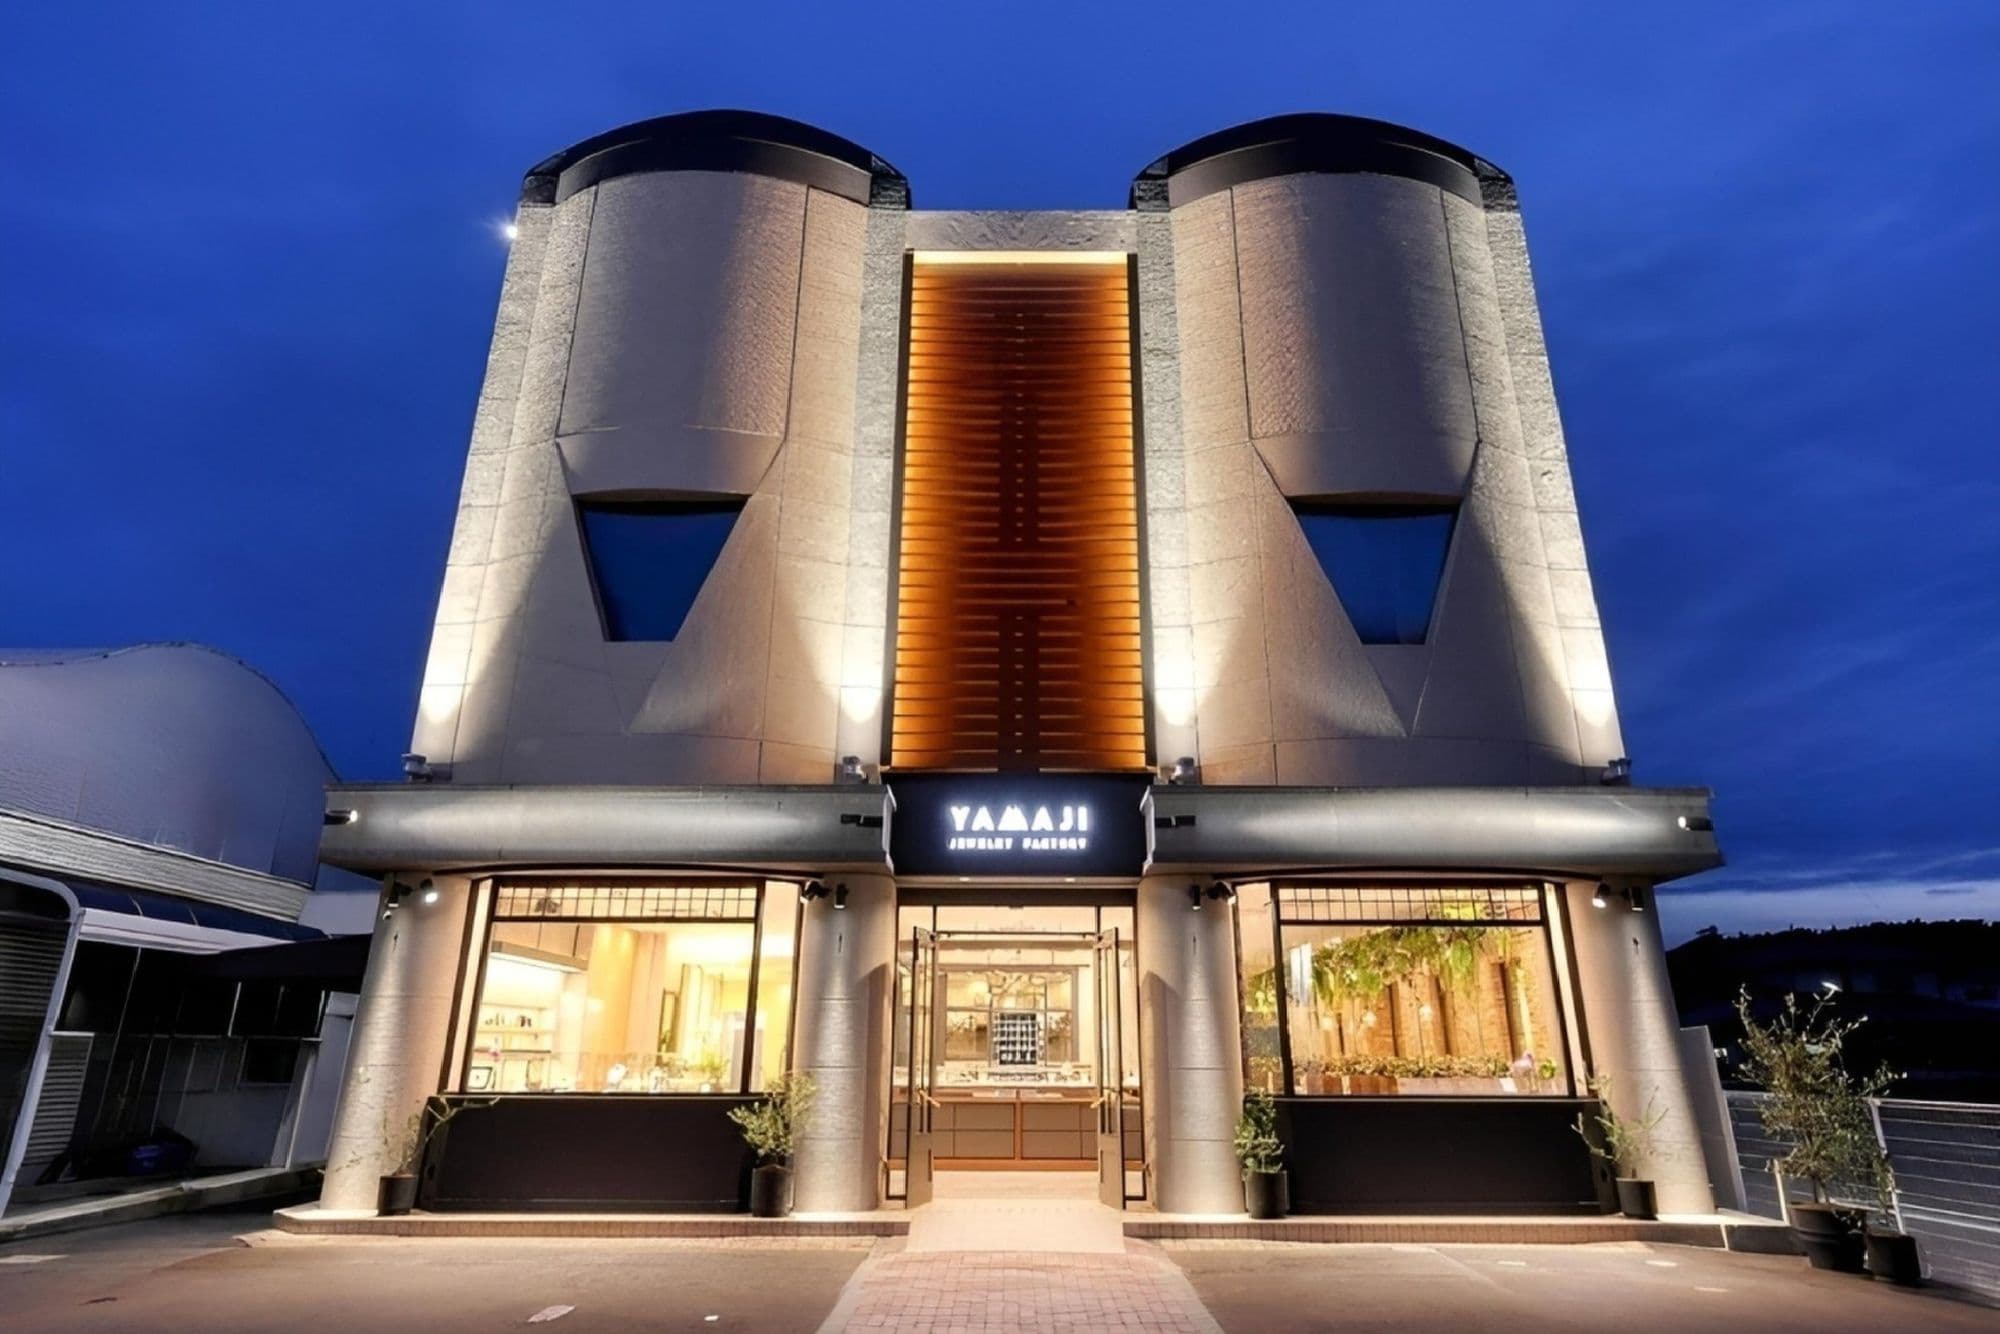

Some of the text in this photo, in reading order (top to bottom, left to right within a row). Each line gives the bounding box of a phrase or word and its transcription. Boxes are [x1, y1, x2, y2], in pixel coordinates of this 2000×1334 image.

[949, 804, 1089, 832] YAMAJI
[949, 837, 1087, 850] JEWELRY FACTORY
